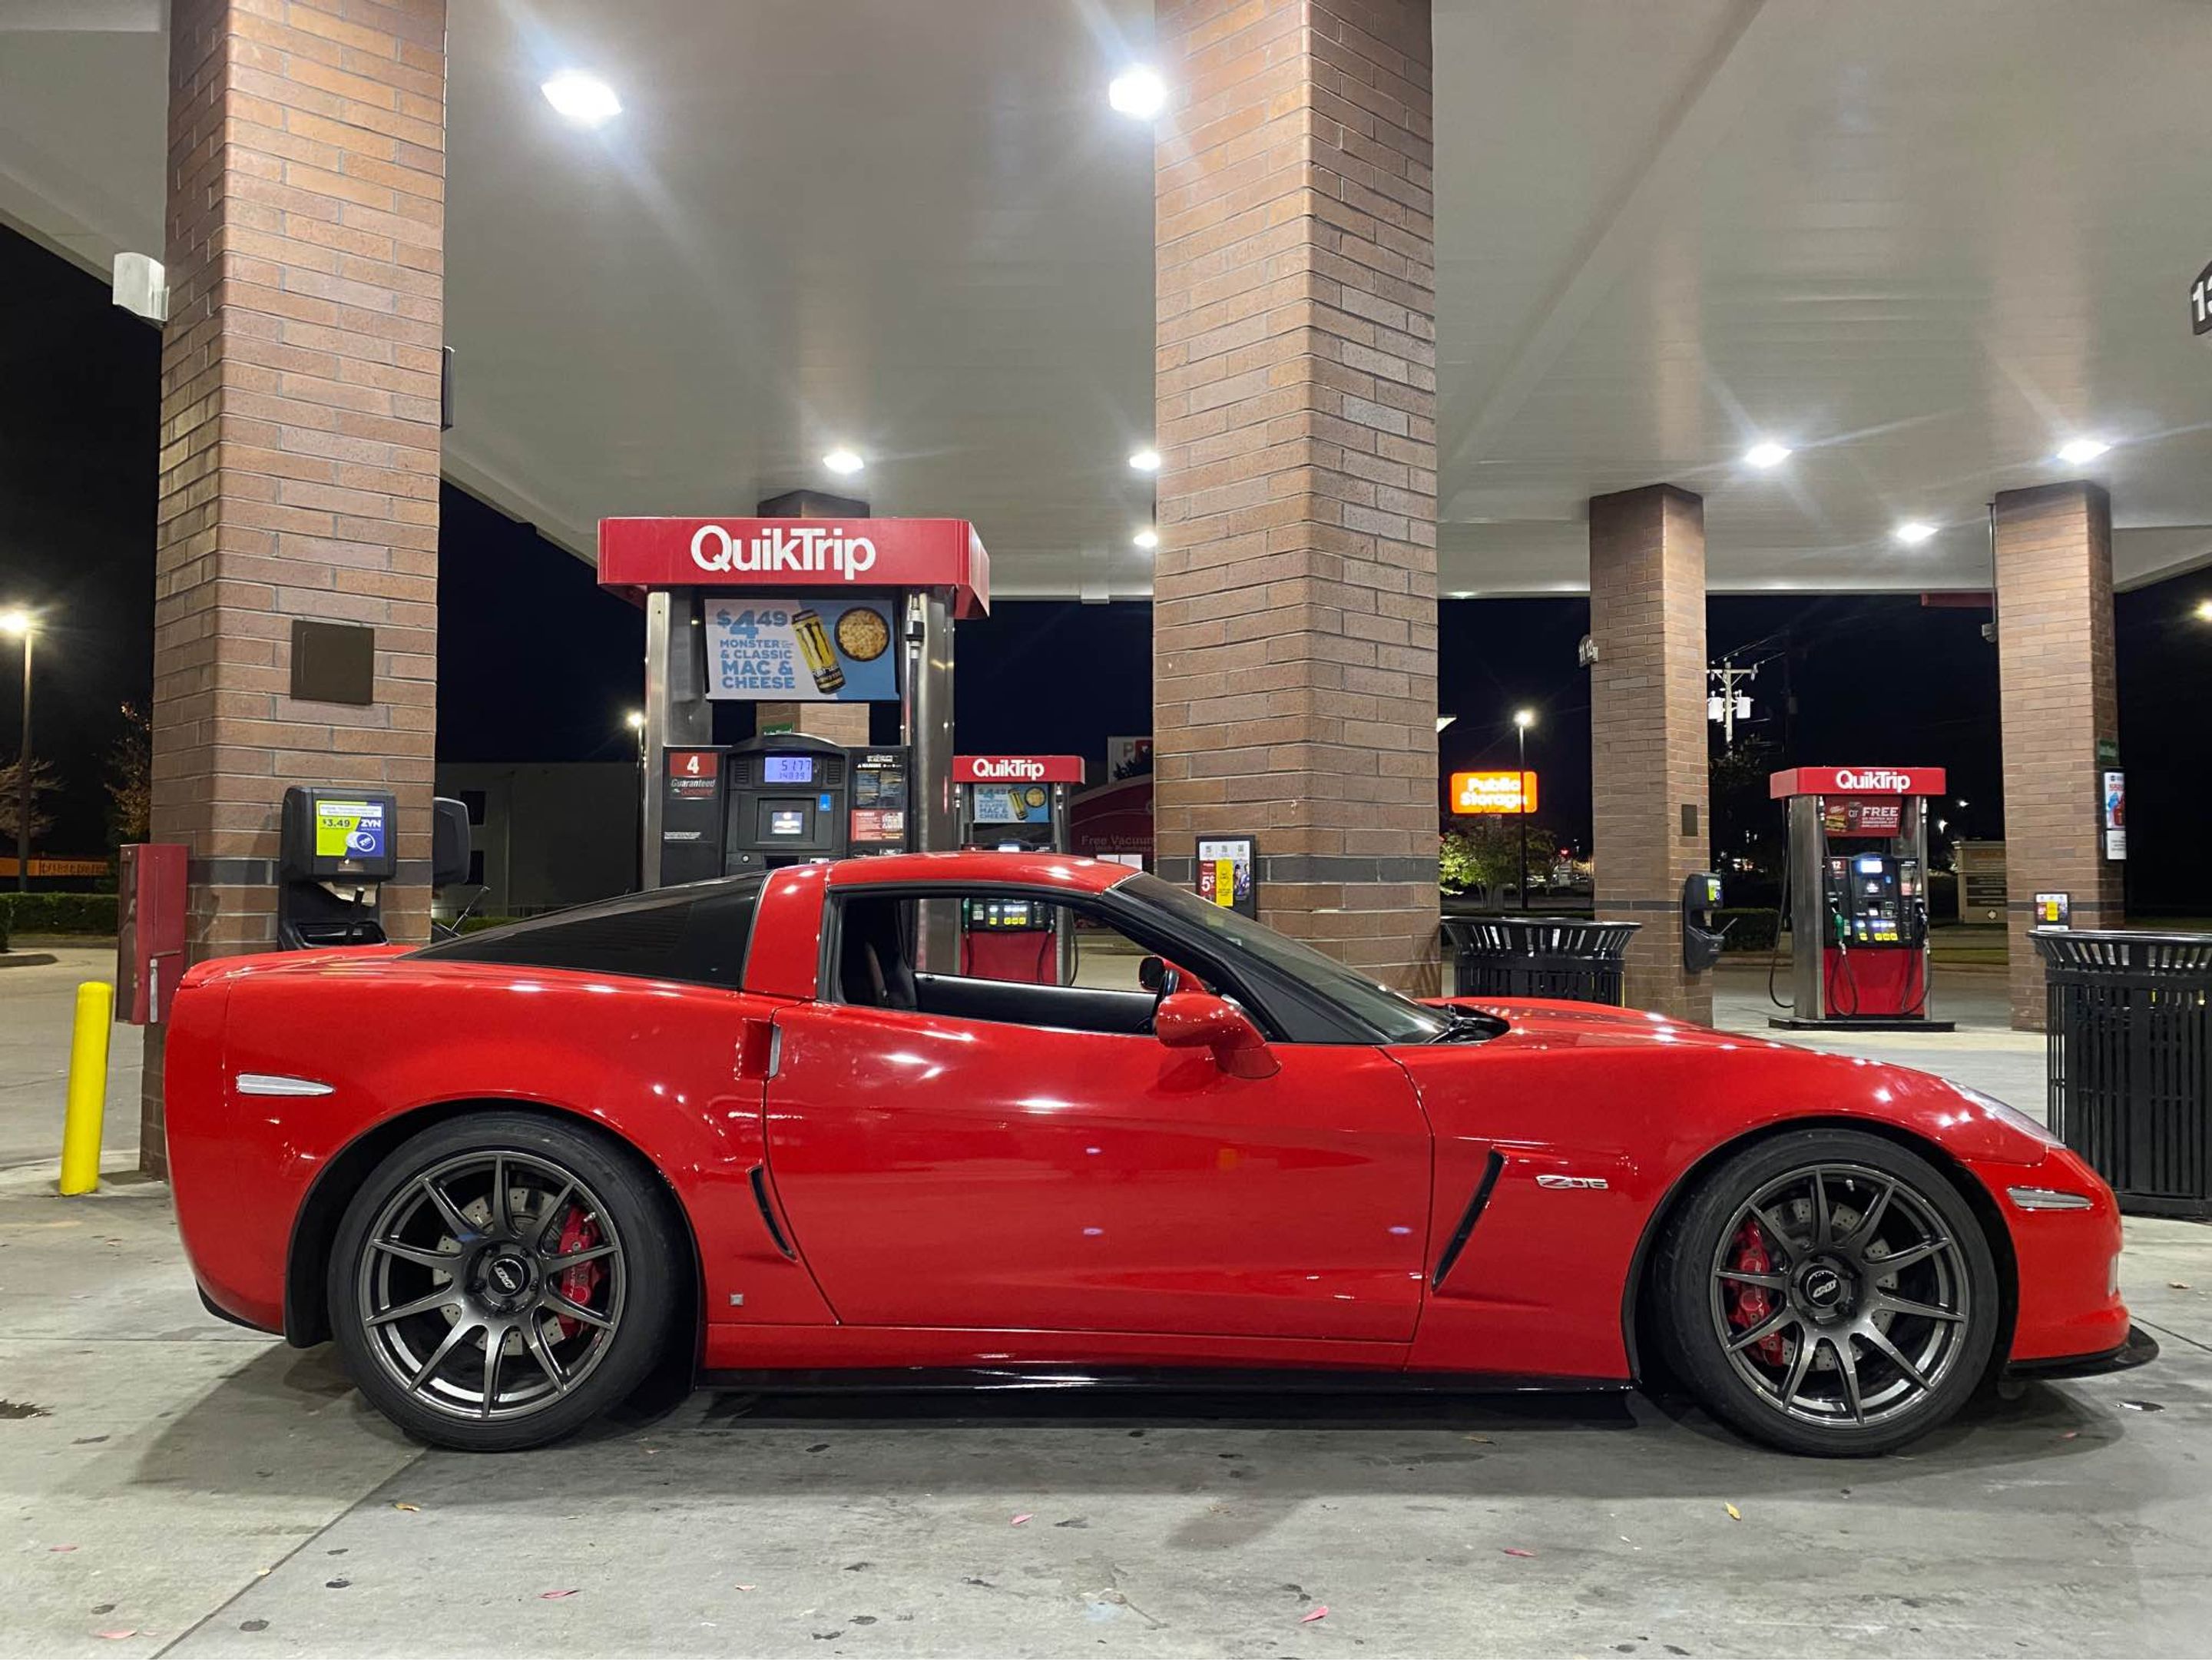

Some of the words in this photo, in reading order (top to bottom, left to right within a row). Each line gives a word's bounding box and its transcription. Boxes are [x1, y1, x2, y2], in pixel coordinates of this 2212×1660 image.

[690, 525, 876, 581] QuikTrip
[720, 639, 780, 648] MONSTER
[720, 649, 730, 659] &
[733, 649, 793, 659] CLASSIC
[722, 661, 770, 675] MAC
[778, 661, 793, 675] &
[722, 677, 796, 689] CHEESE
[687, 755, 700, 774] 4
[972, 758, 1045, 780] QuikTrip
[671, 779, 716, 787] Guaranteed
[1468, 777, 1521, 791] Public
[1836, 770, 1911, 793] QuikTrip
[1460, 792, 1528, 809] Storage
[1862, 807, 1899, 817] FREE
[1081, 836, 1108, 845] Free
[1536, 1175, 1608, 1189] Z06
